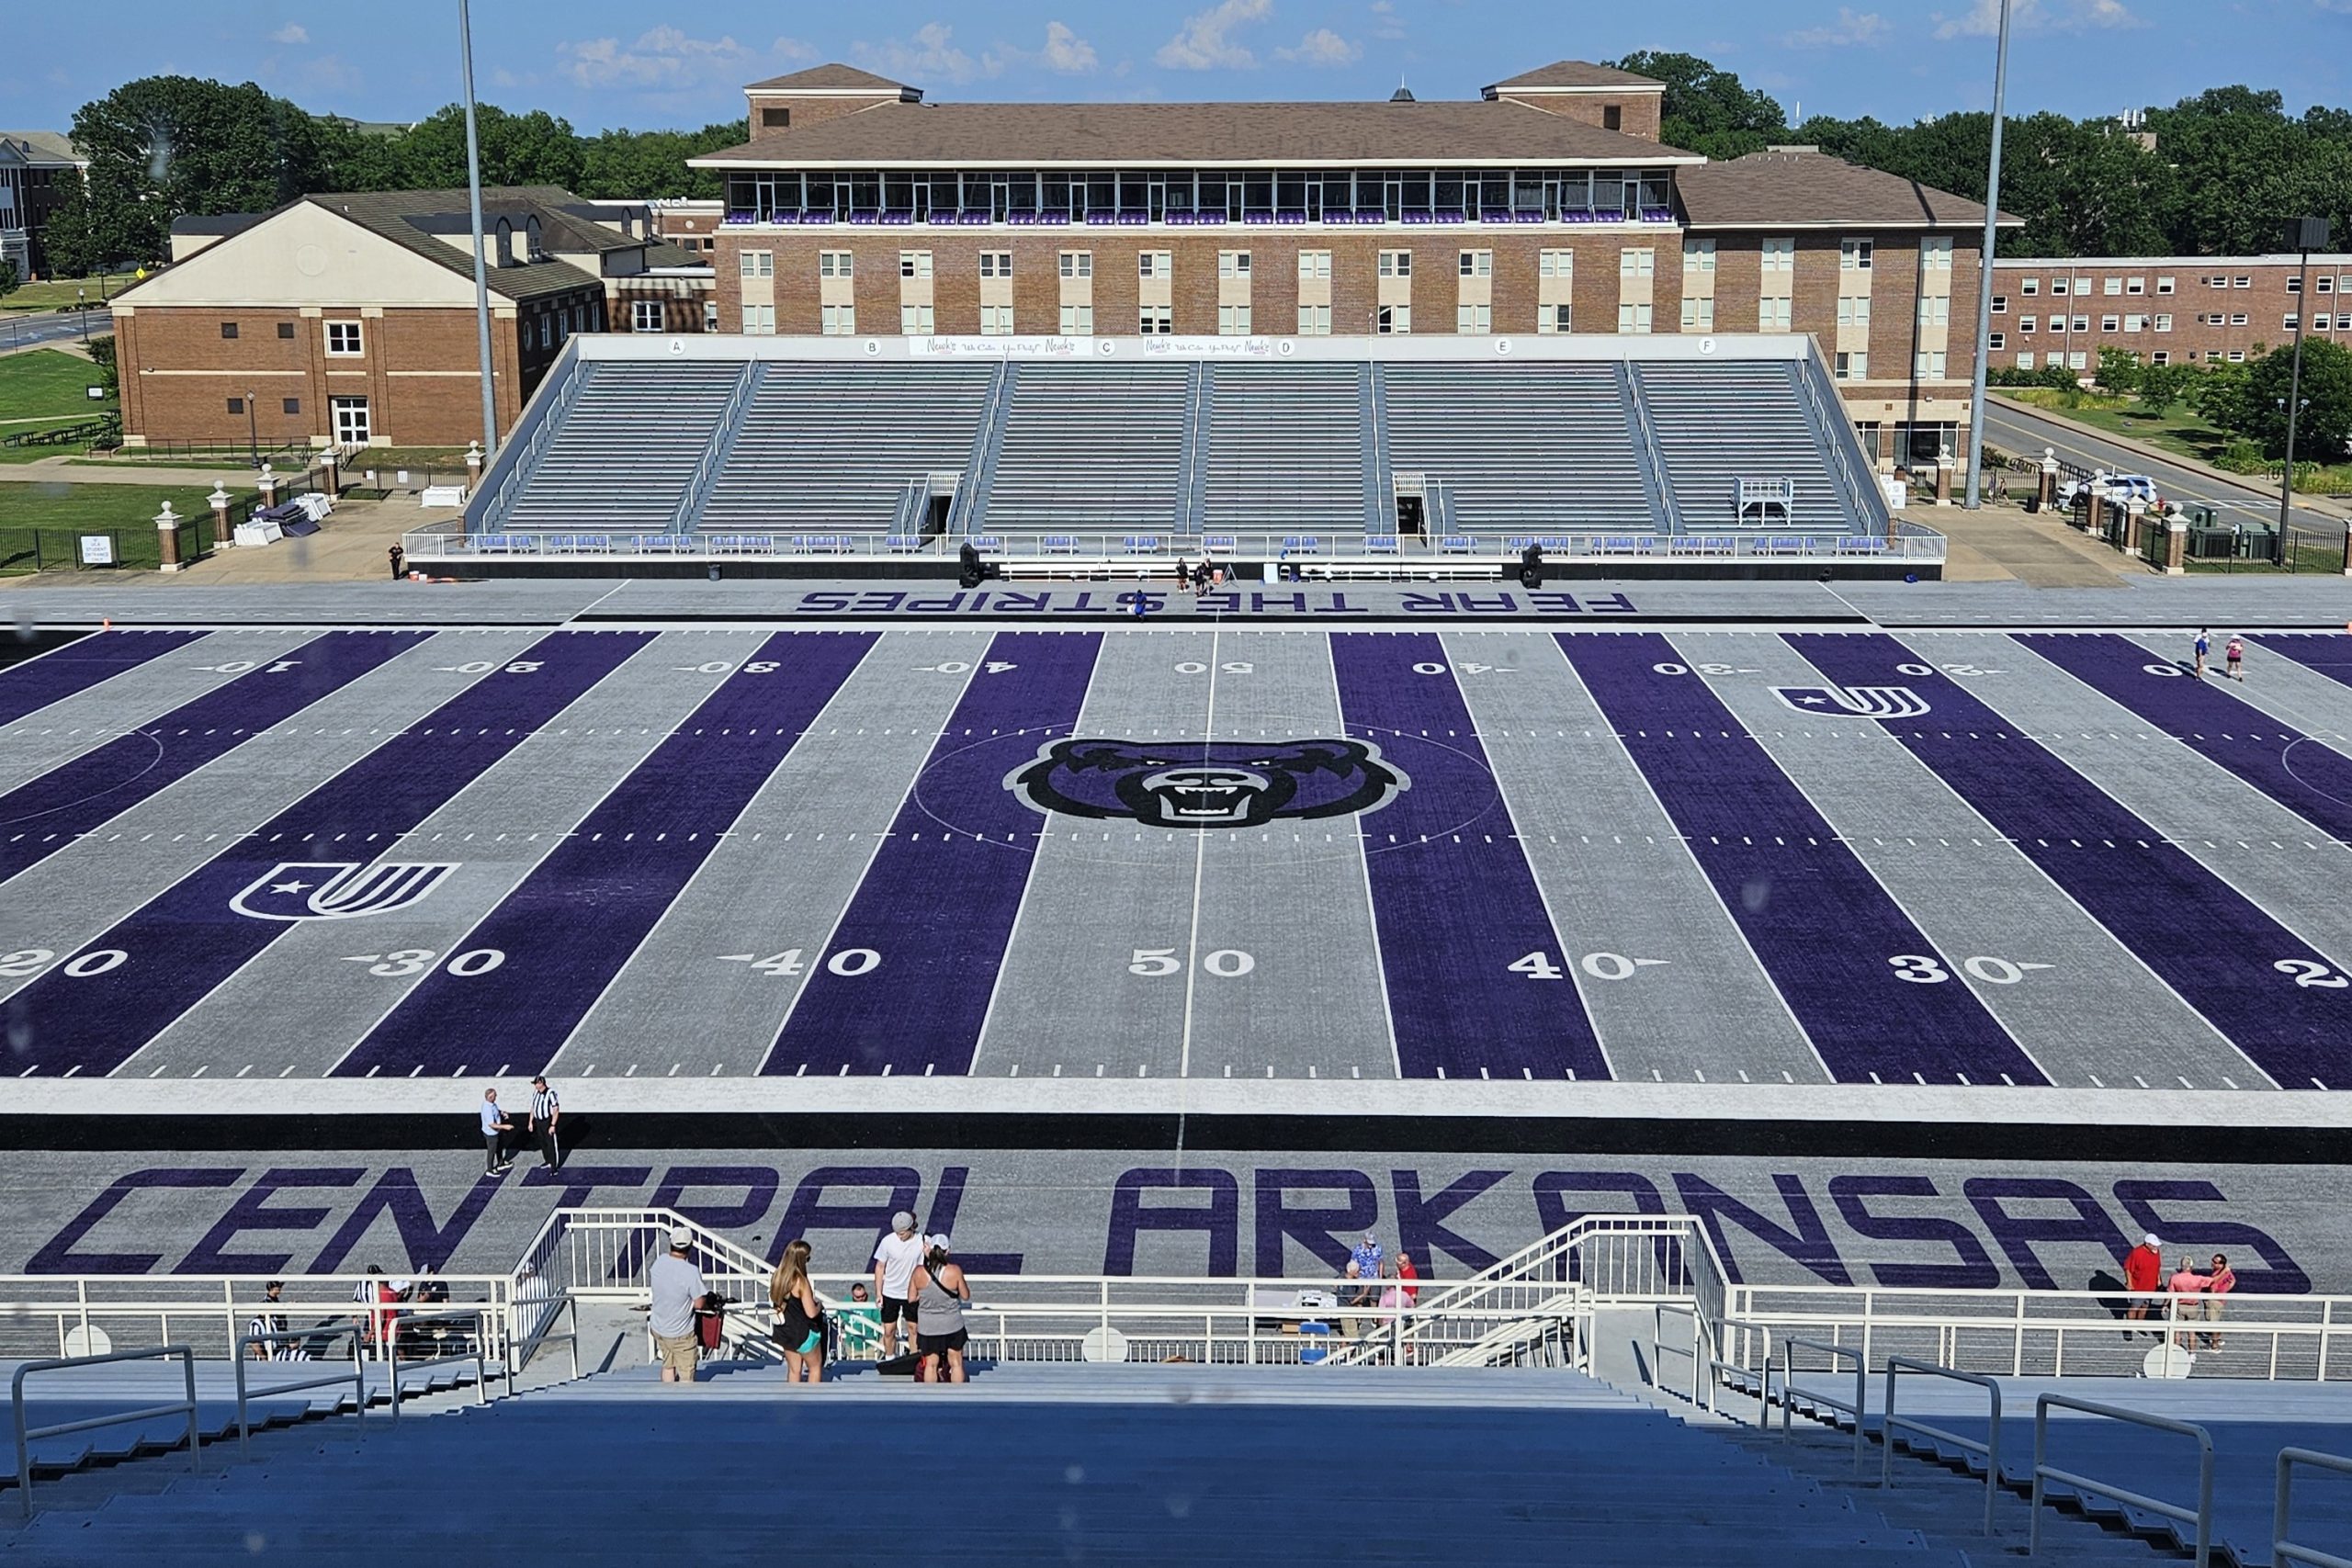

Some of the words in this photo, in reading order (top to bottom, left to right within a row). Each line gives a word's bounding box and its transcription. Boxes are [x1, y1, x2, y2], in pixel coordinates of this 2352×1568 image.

[673, 342, 681, 352] A
[868, 343, 876, 352] B
[1102, 343, 1111, 352] C
[1283, 343, 1290, 352] D
[1499, 342, 1507, 351] E
[1703, 341, 1711, 350] F
[795, 592, 1168, 613] STRIPES
[1196, 591, 1368, 613] THE
[1397, 592, 1638, 613] FEAR
[1103, 1167, 2312, 1295] ARKANSAS
